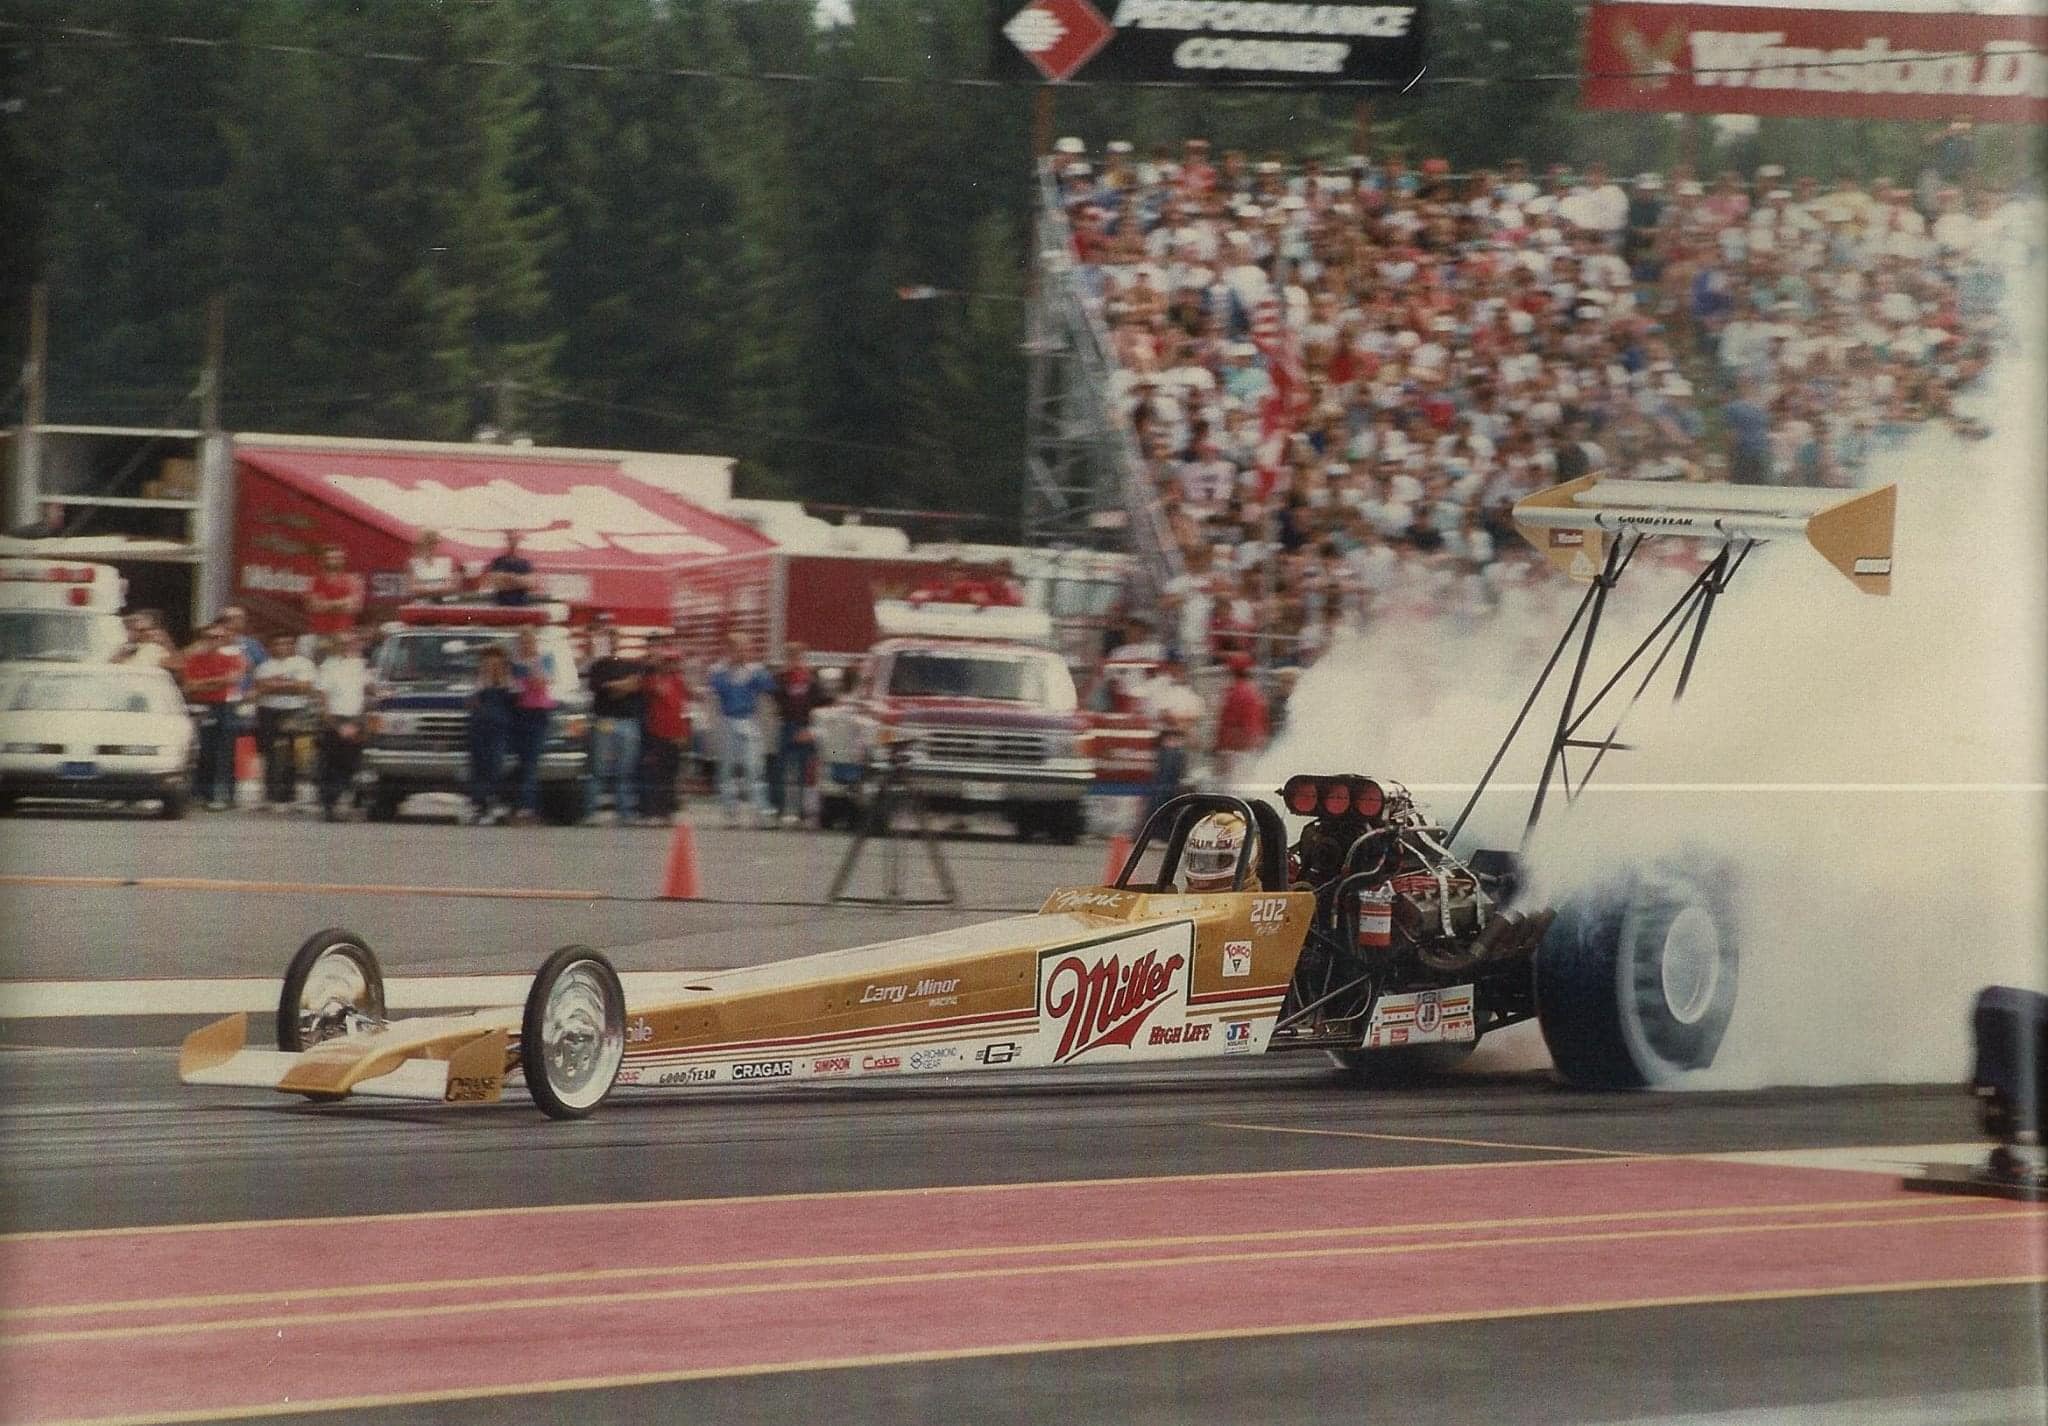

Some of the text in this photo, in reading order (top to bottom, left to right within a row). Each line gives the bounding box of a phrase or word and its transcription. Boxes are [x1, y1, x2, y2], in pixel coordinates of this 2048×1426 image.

[1689, 31, 1975, 95] Winston
[1250, 898, 1287, 922] 202
[860, 978, 961, 1003] Larry Minor
[1045, 949, 1185, 1063] Miller
[1226, 1022, 1251, 1041] JE
[659, 1067, 716, 1085] GOODYEAR
[733, 1062, 792, 1079] CRAGAR
